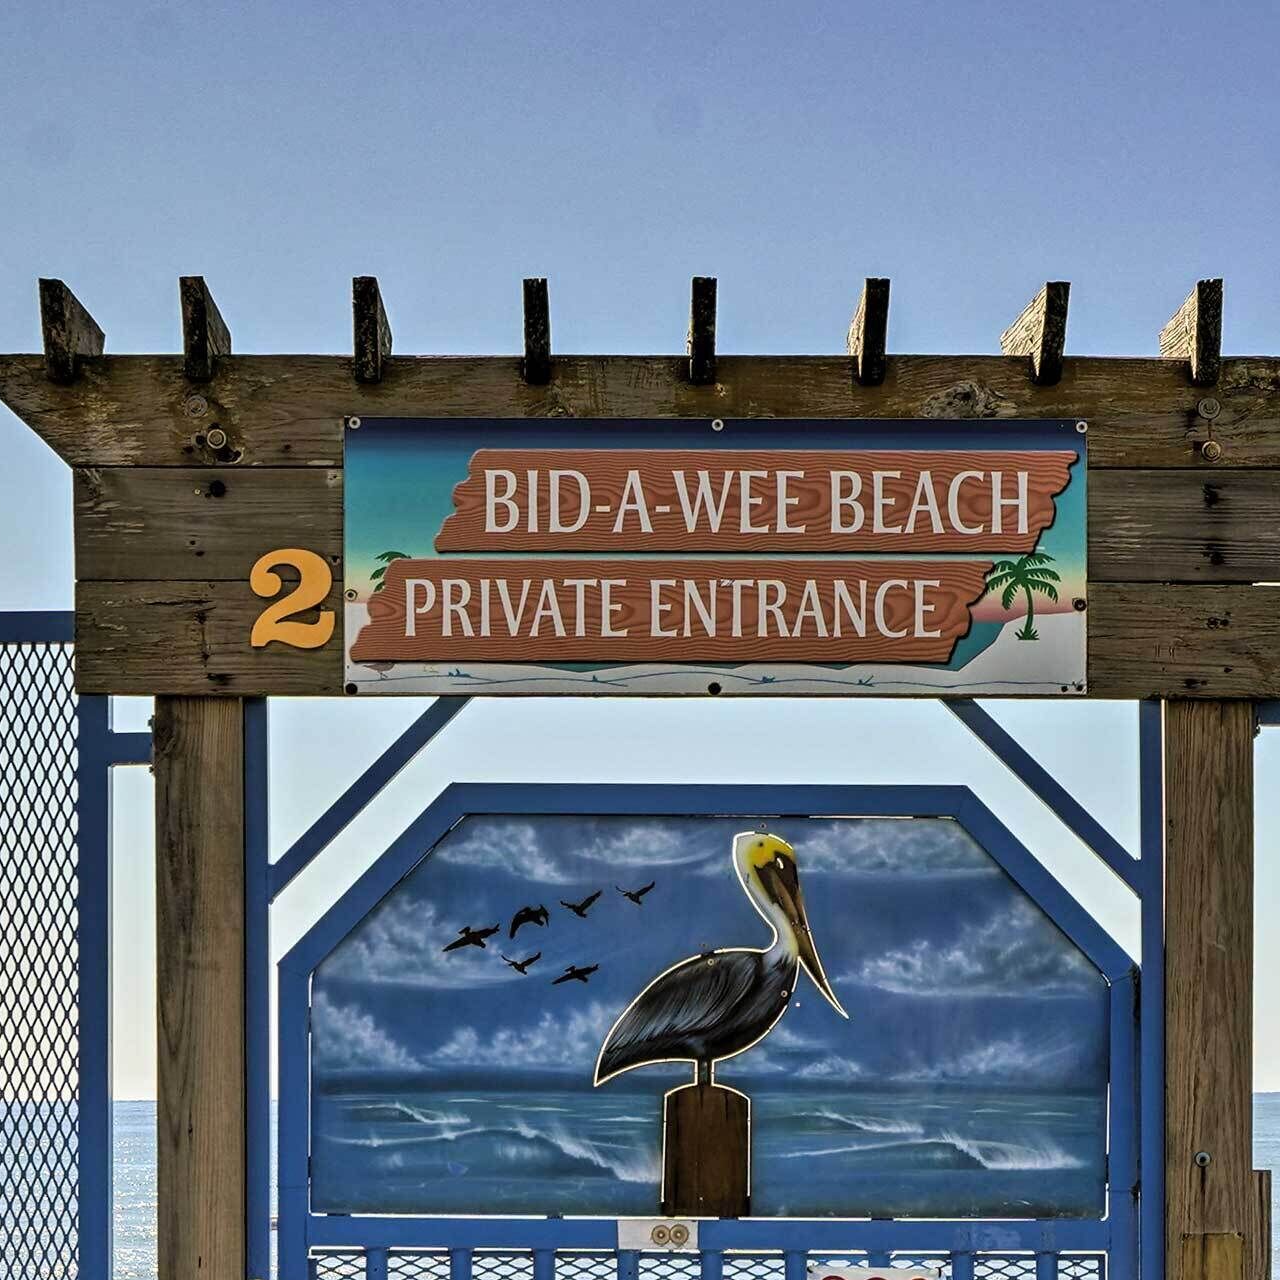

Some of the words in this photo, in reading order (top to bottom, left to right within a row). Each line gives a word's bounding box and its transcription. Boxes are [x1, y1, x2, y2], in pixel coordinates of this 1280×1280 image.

[484, 468, 806, 534] BID-A-WEE
[830, 470, 1029, 534] BEACH
[249, 548, 335, 649] 2
[405, 578, 628, 637] PRIVATE
[650, 579, 941, 638] ENTRANCE
